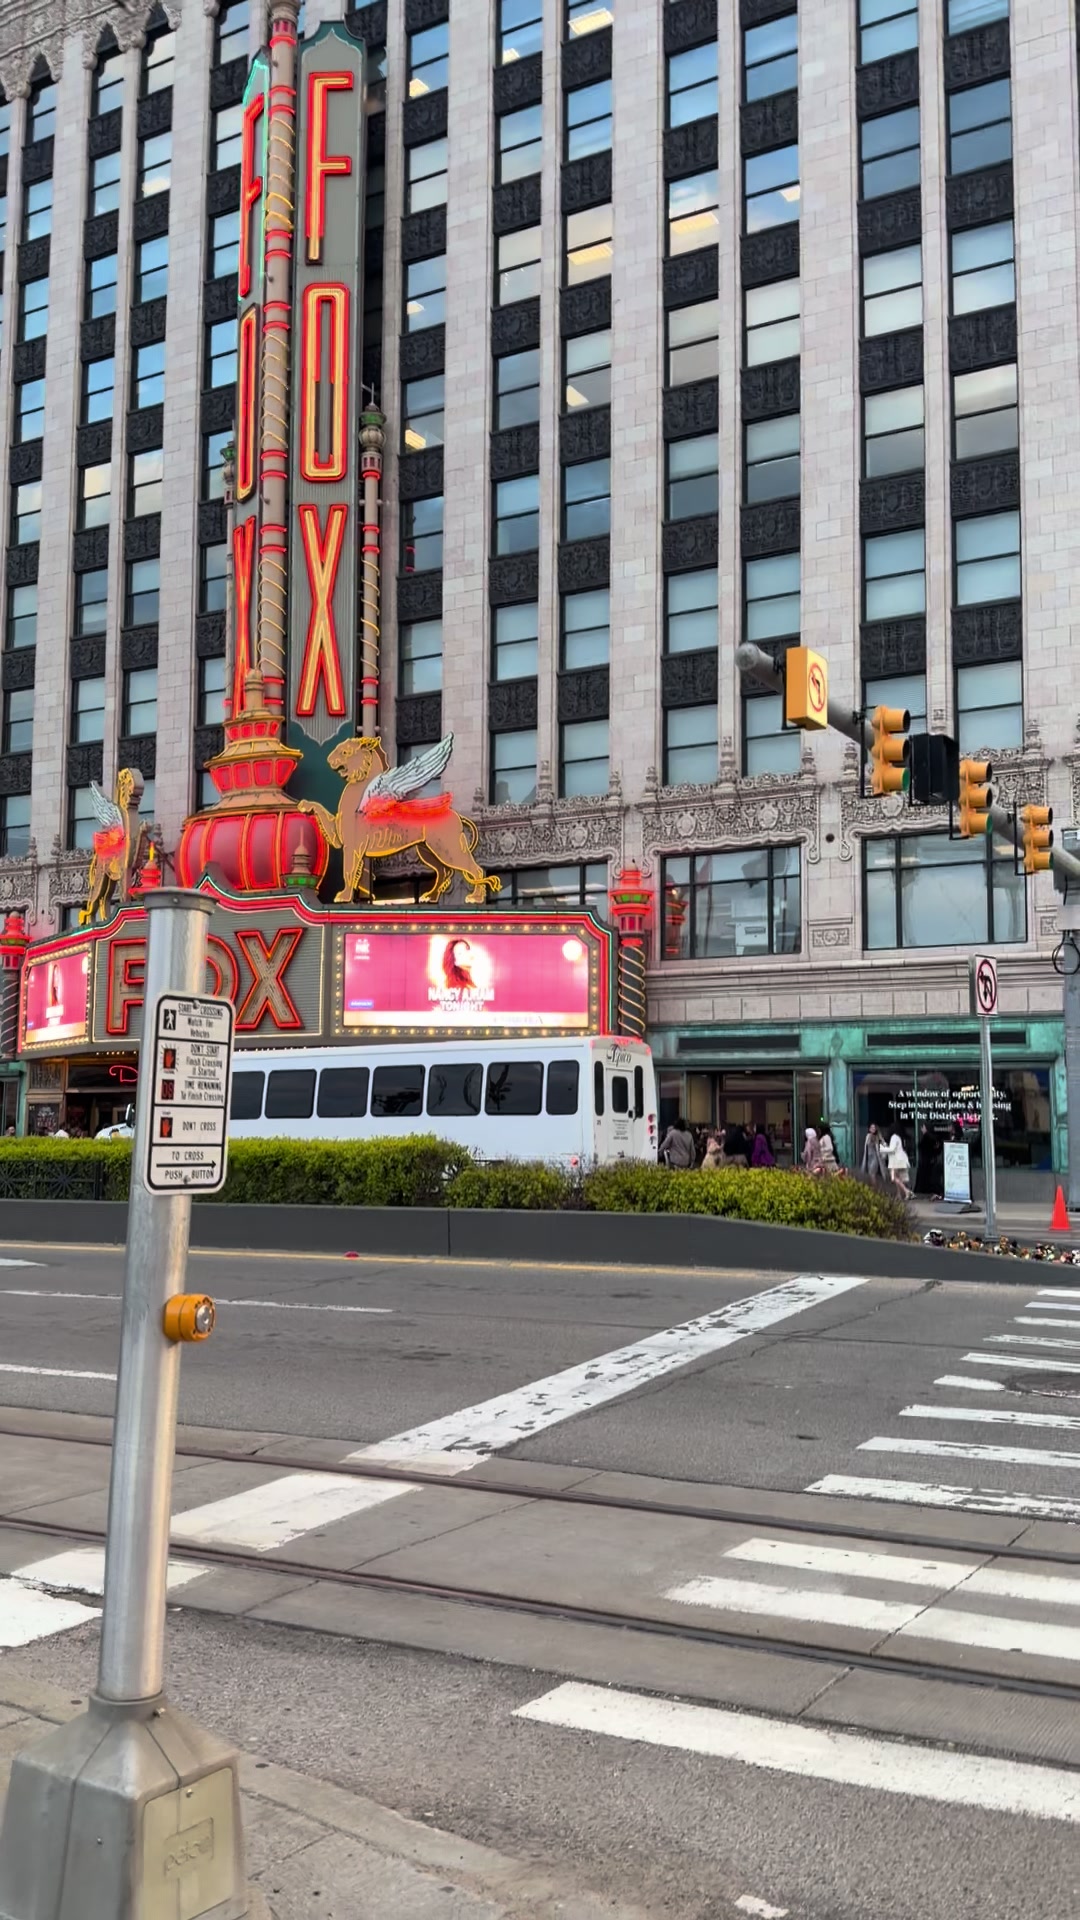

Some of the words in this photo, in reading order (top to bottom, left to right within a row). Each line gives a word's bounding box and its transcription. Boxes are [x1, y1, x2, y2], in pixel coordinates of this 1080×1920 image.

[298, 71, 355, 717] FOX
[428, 987, 460, 1001] NANCY
[200, 1005, 223, 1017] CROSSING
[440, 1001, 485, 1012] TONIGHT
[186, 1056, 200, 1066] Finish
[202, 1058, 223, 1069] Crossing
[198, 1067, 216, 1077] Started
[198, 1081, 221, 1091] REMAINING
[188, 1091, 202, 1100] Finish
[203, 1092, 224, 1103] Crossing
[898, 1090, 905, 1098] A
[906, 1089, 939, 1098] window
[941, 1089, 950, 1098] of
[888, 1100, 907, 1110] Step
[908, 1100, 934, 1109] inside
[935, 1100, 947, 1109] for
[948, 1101, 966, 1110] jobs
[968, 1101, 975, 1109] &
[976, 1101, 1012, 1112] hsing
[900, 1111, 908, 1120] in
[909, 1111, 927, 1120] The
[929, 1111, 960, 1121] District
[200, 1121, 217, 1131] CROSS
[172, 1151, 180, 1161] TO
[184, 1151, 204, 1161] CROSS
[165, 1170, 183, 1180] PUSH
[191, 1169, 215, 1180] BUTTON
